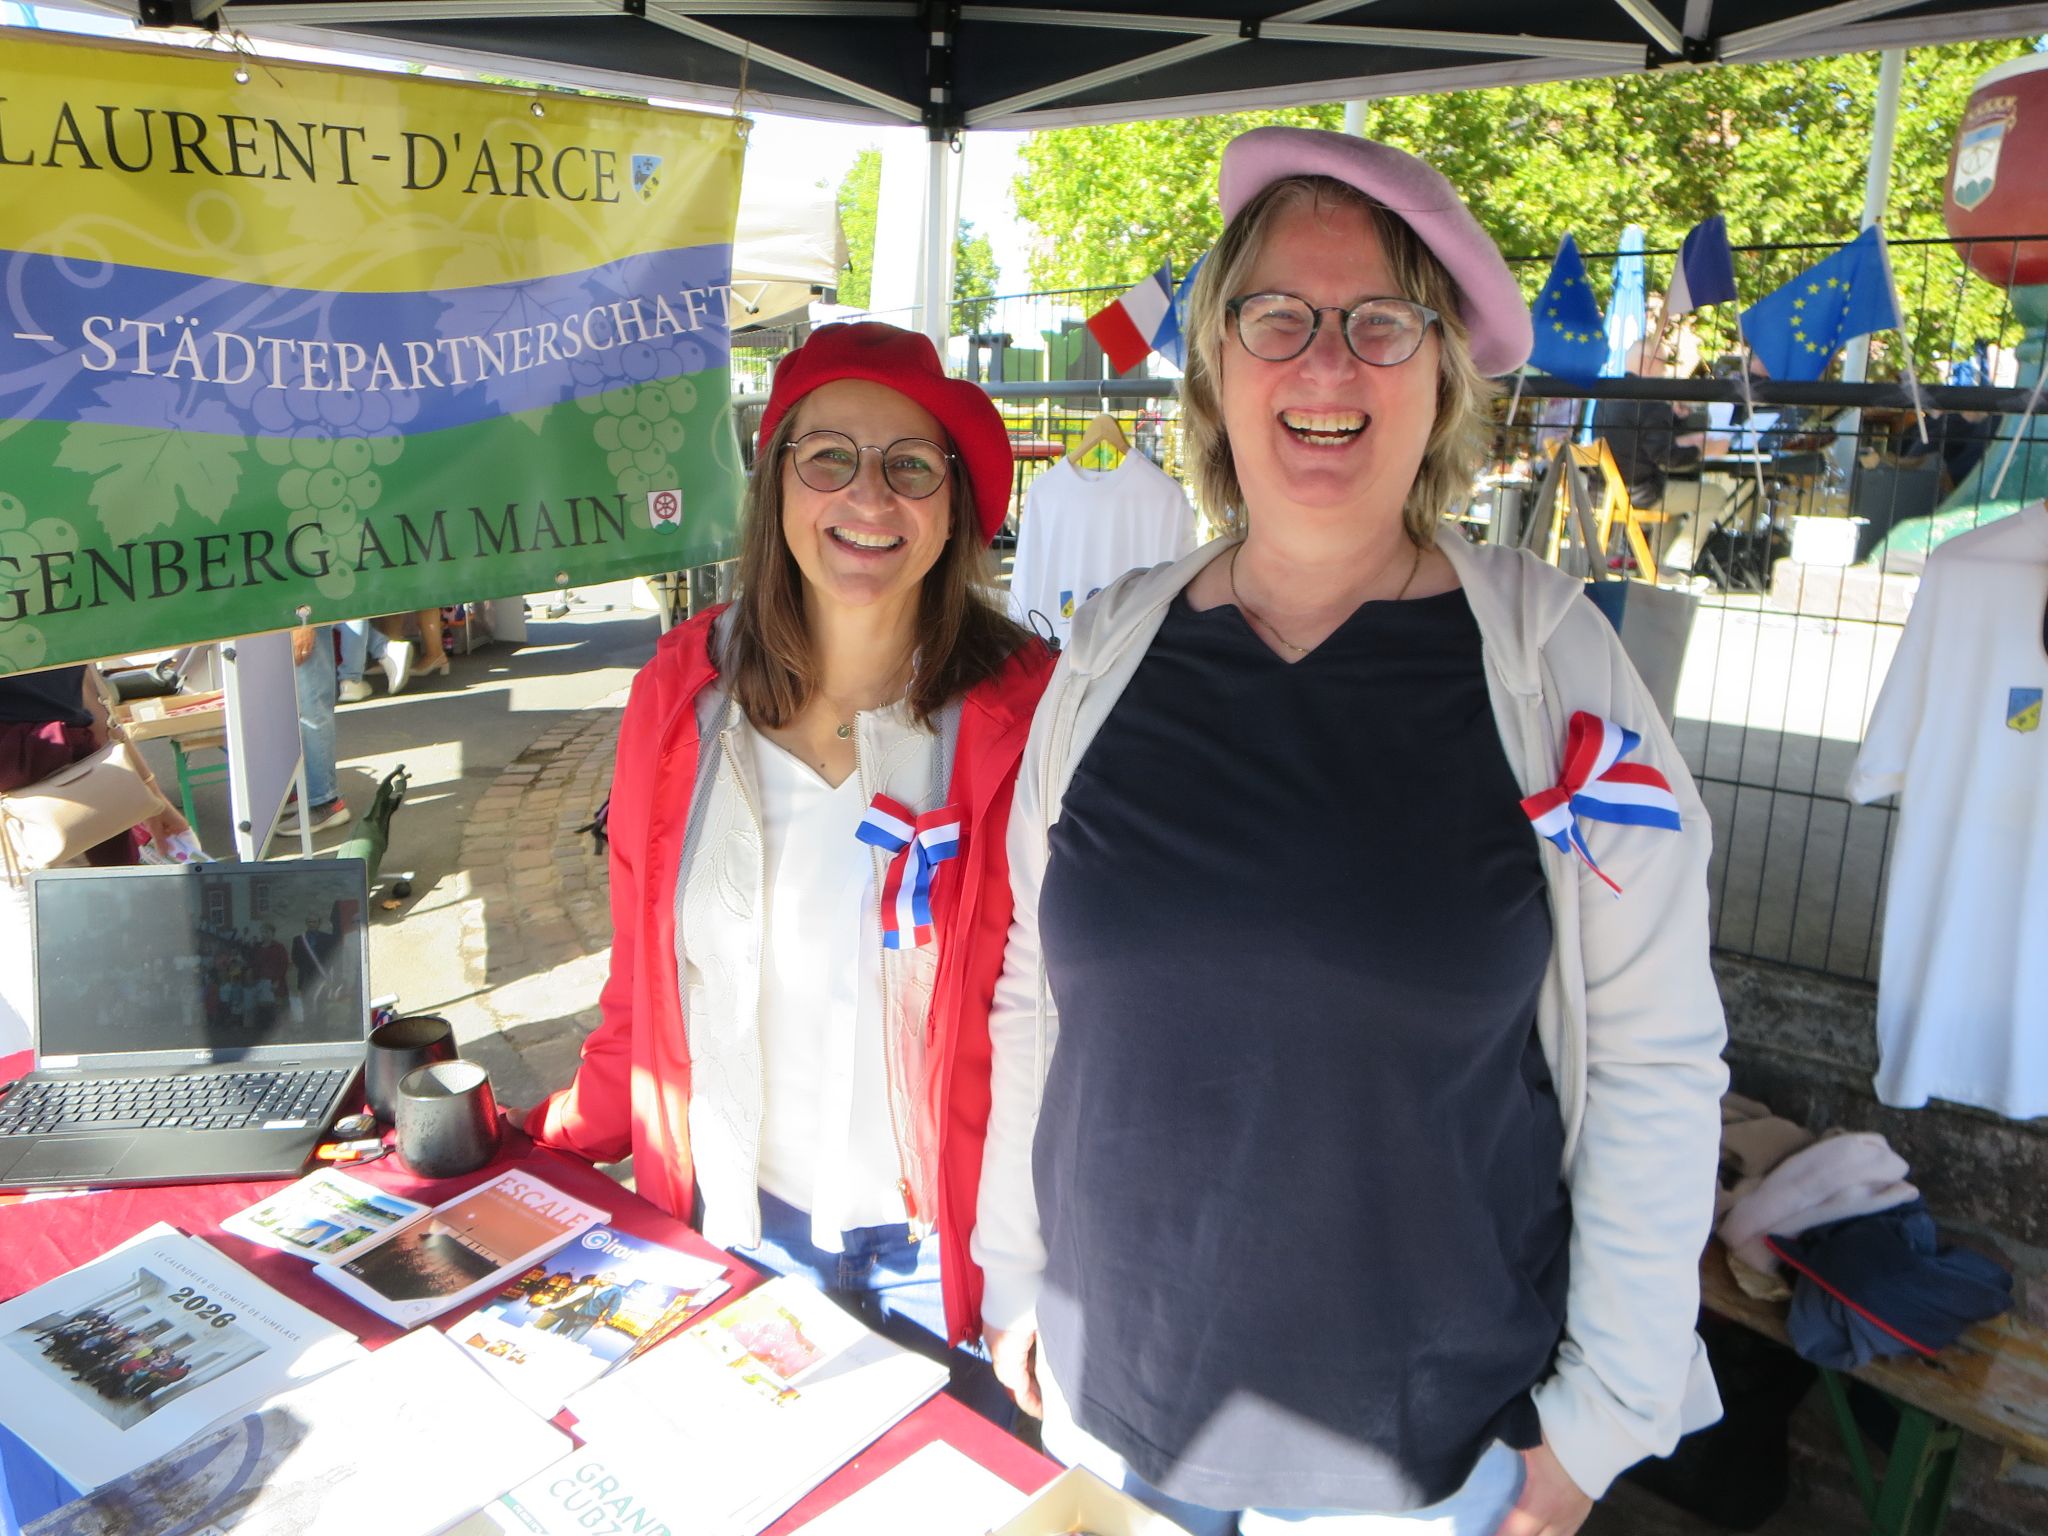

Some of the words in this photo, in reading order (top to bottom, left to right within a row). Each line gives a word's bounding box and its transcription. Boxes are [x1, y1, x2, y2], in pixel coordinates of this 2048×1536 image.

[0, 97, 621, 203] LAURENT-D'ARCE
[81, 285, 731, 395] STÄDTEPARTNERSCHAFT
[353, 510, 456, 572] AM
[467, 493, 627, 558] MAIN
[495, 1176, 590, 1229] ESCALE
[164, 1255, 208, 1285] CALENDRIER
[248, 1306, 262, 1318] DE
[260, 1314, 301, 1342] JUMELAGE
[168, 1286, 237, 1329] 2026
